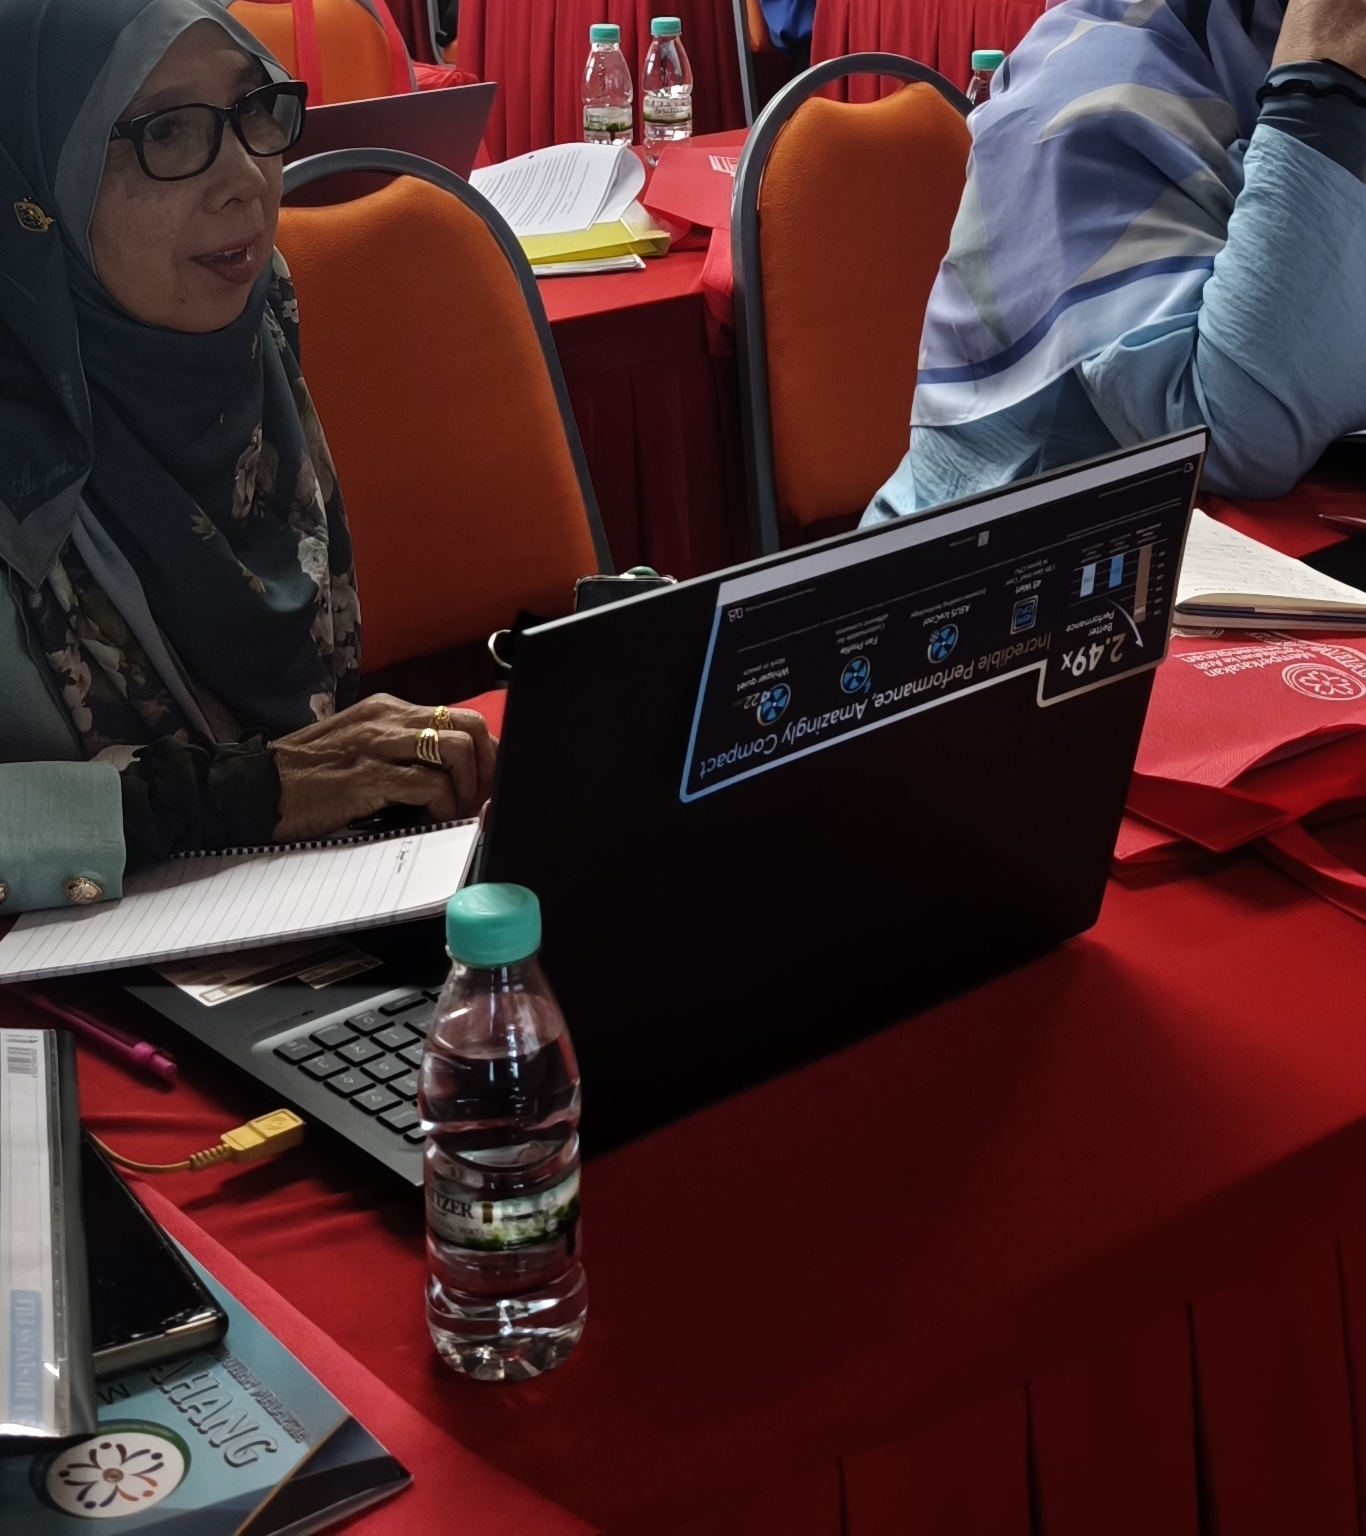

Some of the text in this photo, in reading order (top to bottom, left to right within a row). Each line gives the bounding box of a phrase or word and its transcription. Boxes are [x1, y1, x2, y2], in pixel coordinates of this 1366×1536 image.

[1066, 610, 1114, 632] Performance
[1088, 623, 1112, 636] Better
[1061, 634, 1125, 676] 2.49x
[700, 633, 1051, 778] Incredible Performance, Amazingly Compact
